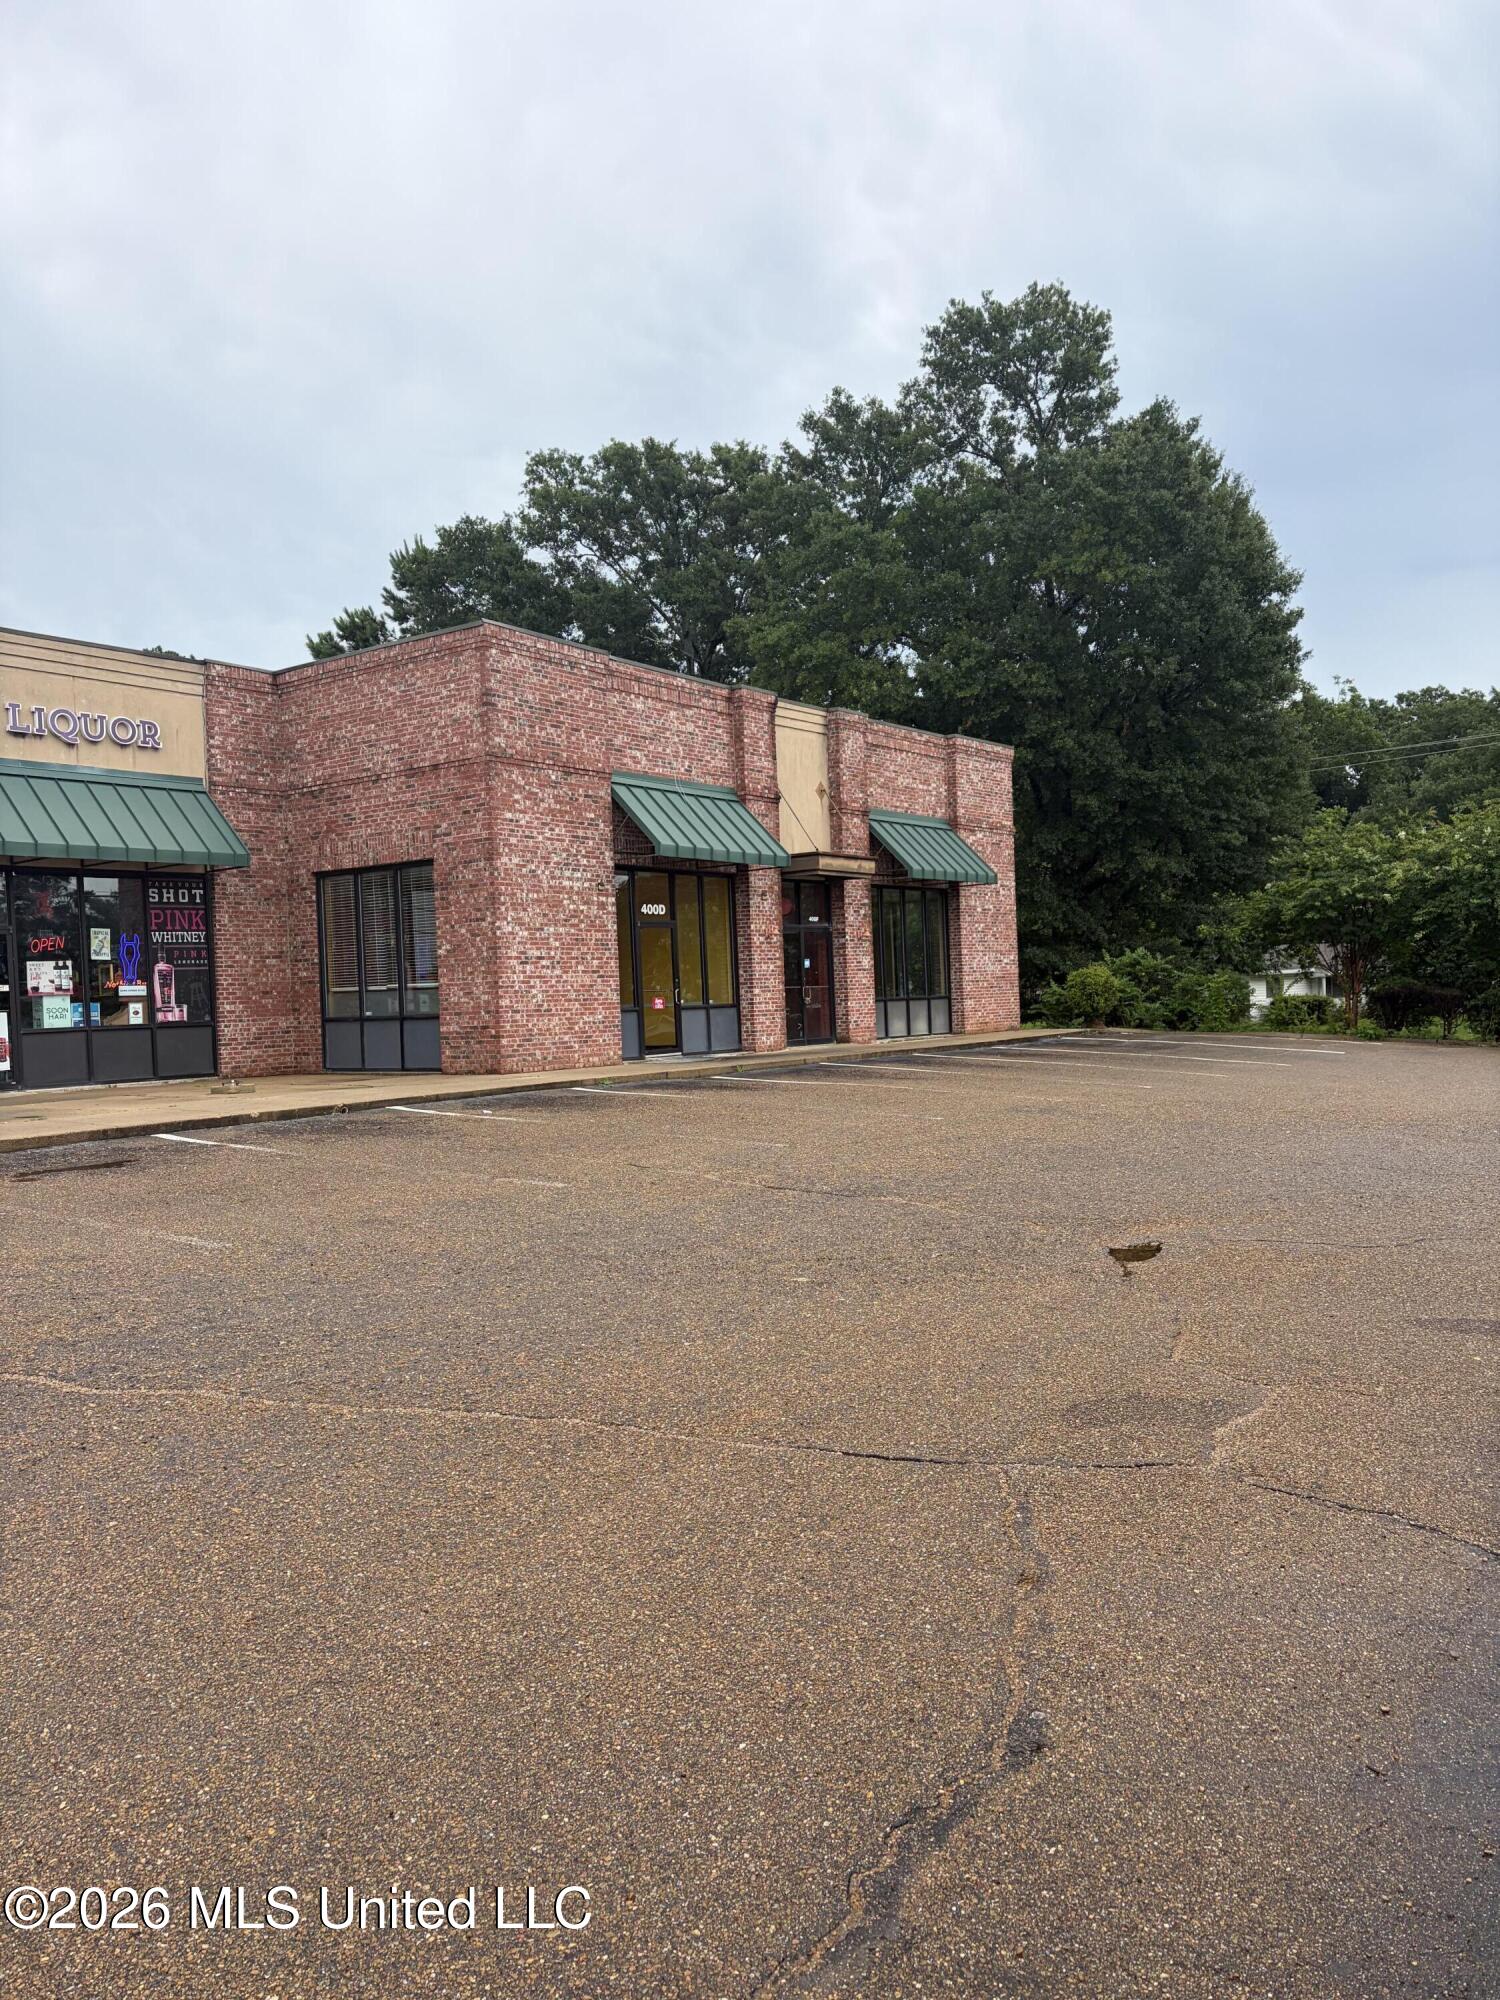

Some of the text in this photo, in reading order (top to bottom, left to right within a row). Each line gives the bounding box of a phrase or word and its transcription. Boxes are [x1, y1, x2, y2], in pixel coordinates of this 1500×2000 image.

[5, 702, 163, 749] LIQUOR
[148, 888, 204, 903] SHOT
[640, 903, 666, 915] 400D
[149, 909, 206, 930] PINK
[31, 935, 65, 953] OPEN
[151, 931, 207, 943] WHITNEY
[174, 950, 207, 958] PINK
